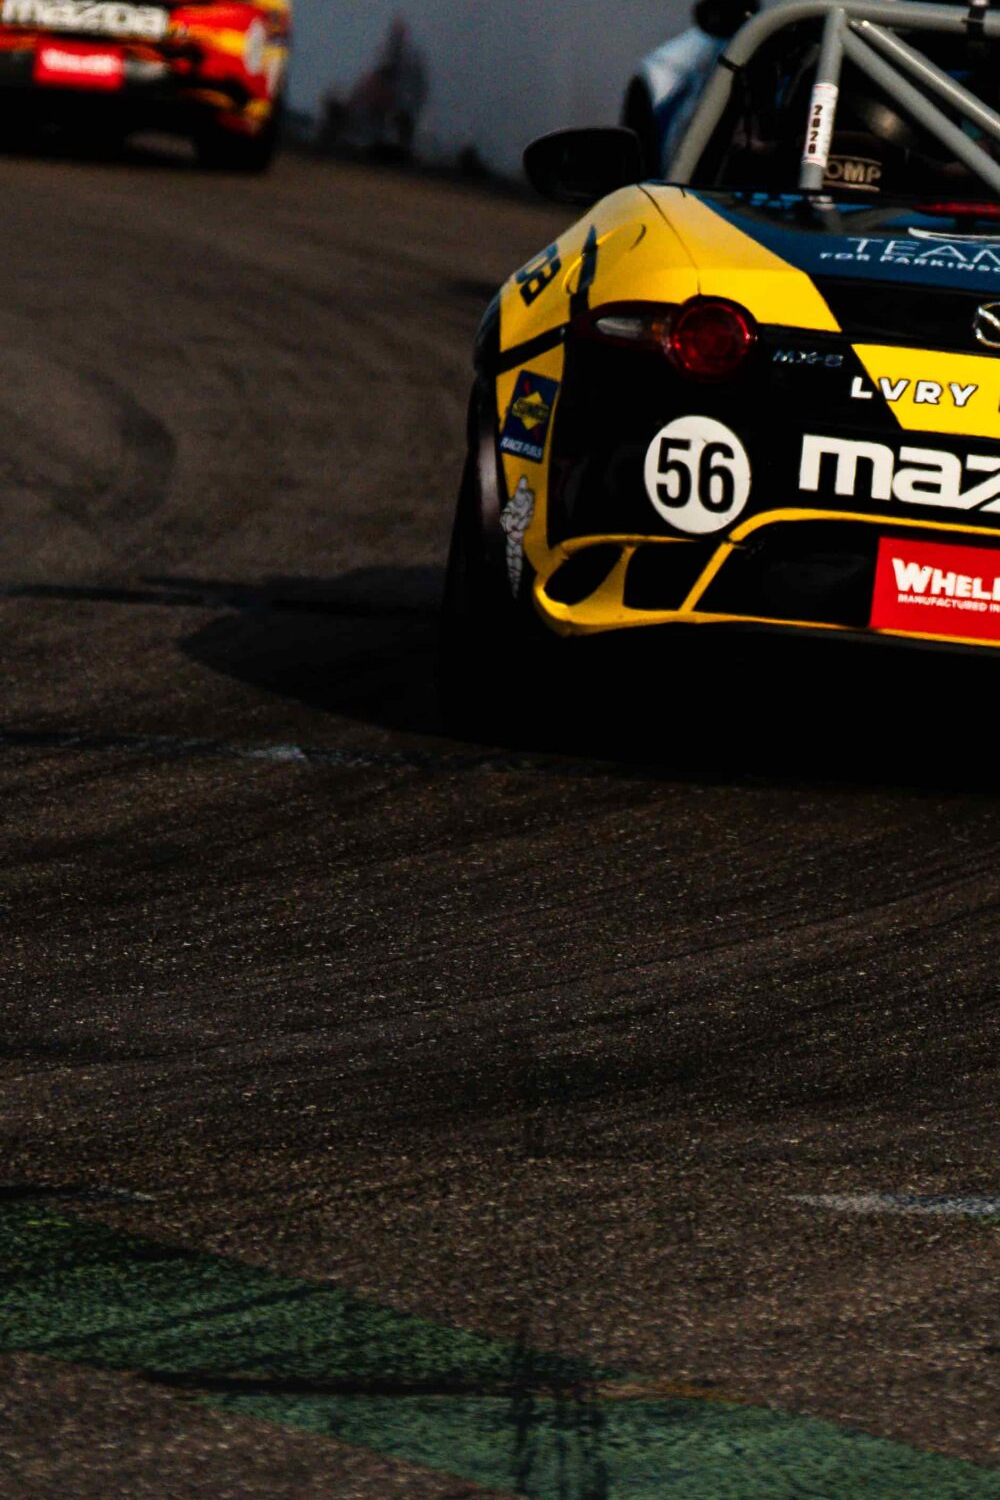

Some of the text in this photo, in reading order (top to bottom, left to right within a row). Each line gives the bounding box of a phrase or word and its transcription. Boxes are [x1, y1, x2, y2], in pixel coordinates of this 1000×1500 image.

[820, 252, 871, 262] FOR
[850, 375, 978, 407] LVRY
[656, 437, 735, 513] 56
[898, 594, 987, 613] MANUFACTURED
